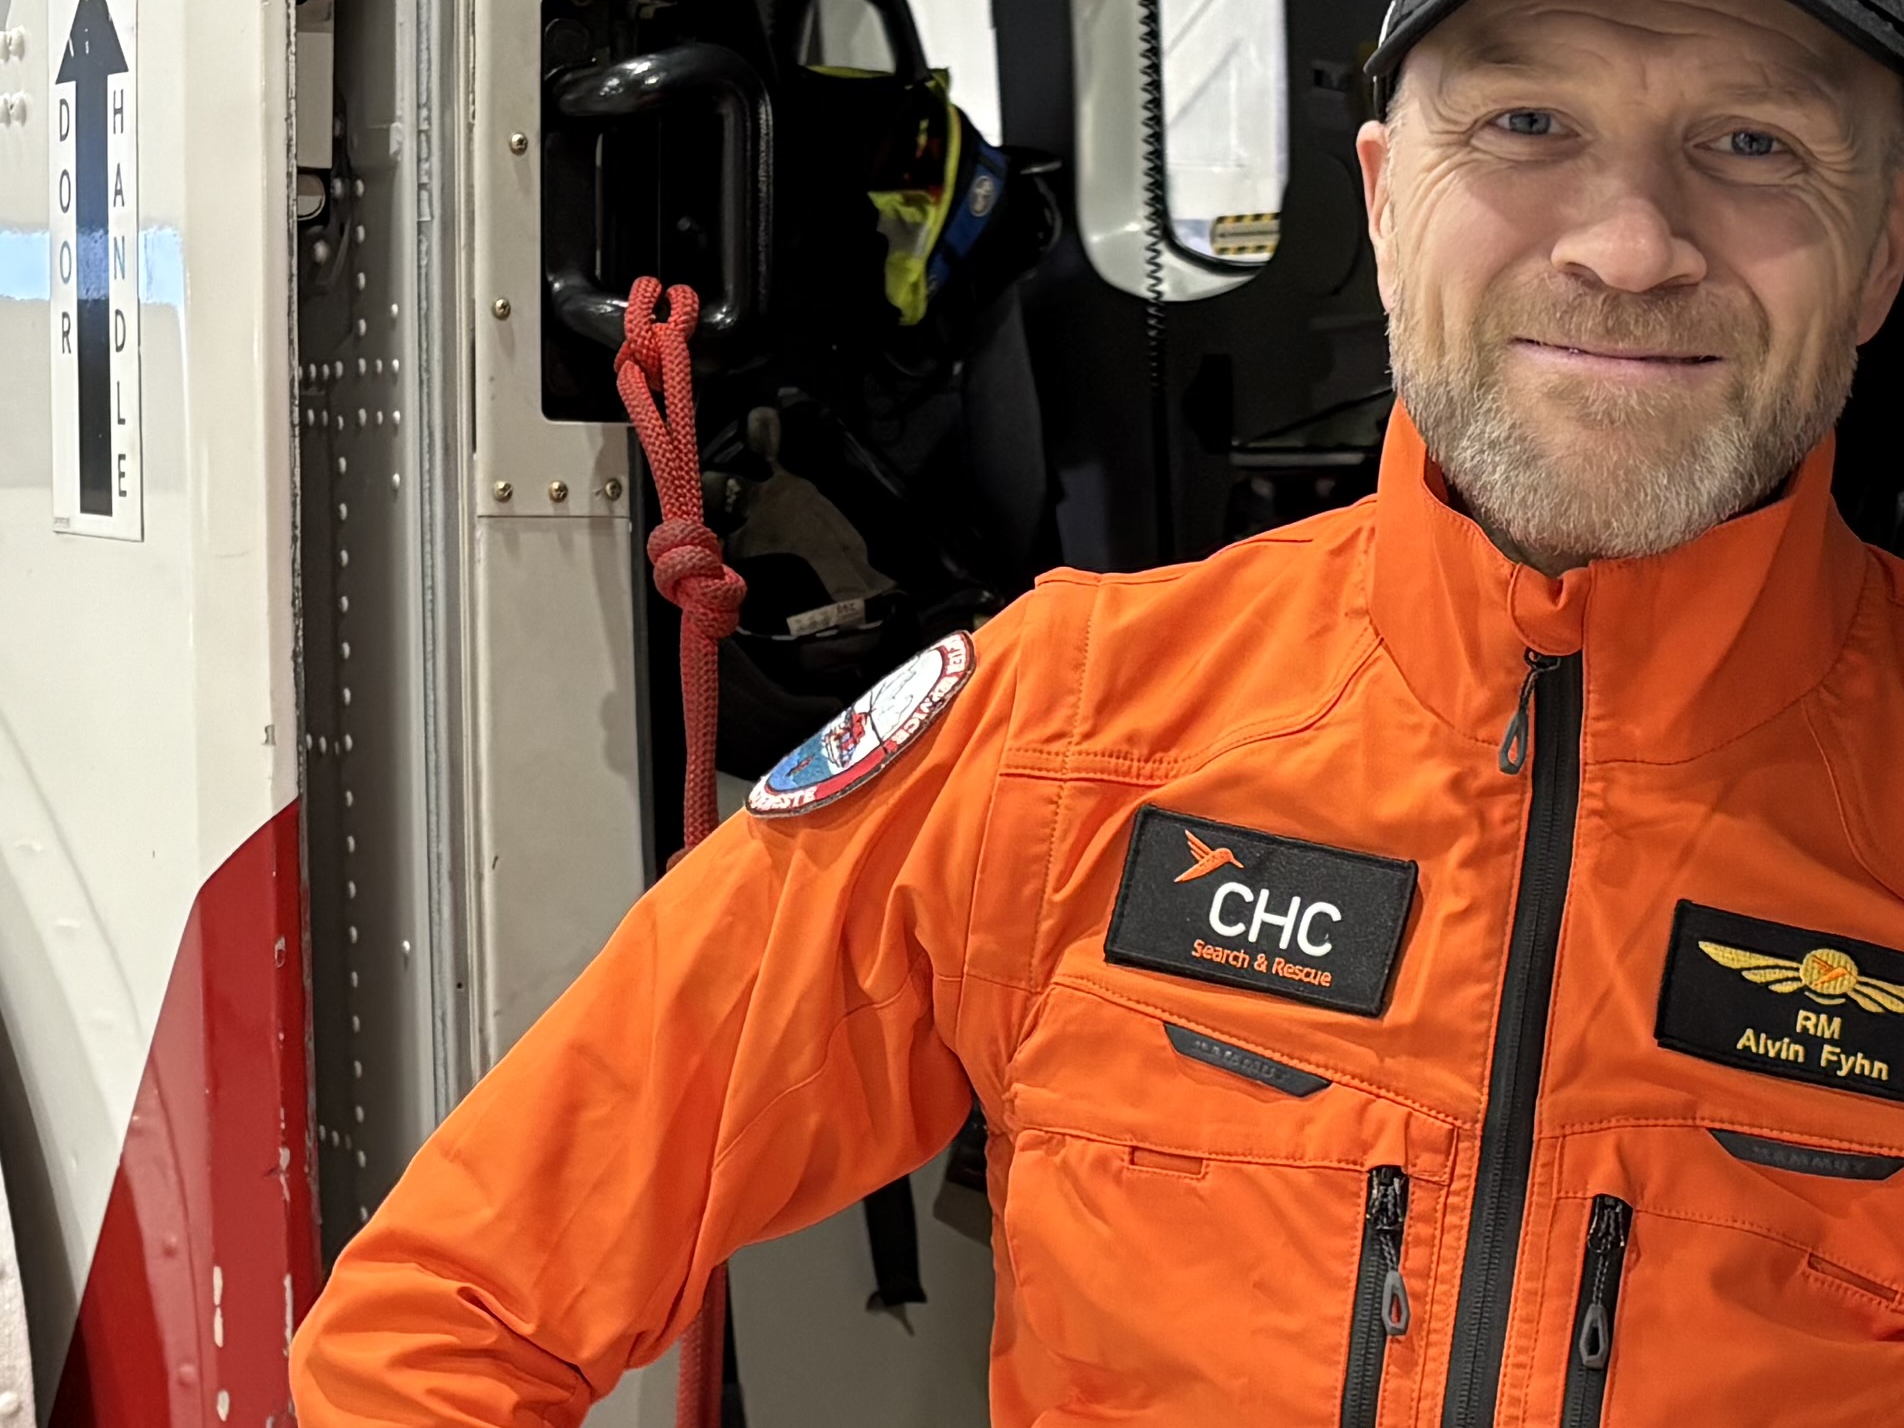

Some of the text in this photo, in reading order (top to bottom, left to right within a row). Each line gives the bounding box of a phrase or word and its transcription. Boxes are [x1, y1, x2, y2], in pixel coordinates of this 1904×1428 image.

[59, 98, 72, 354] DOOR
[112, 89, 127, 497] HANDLE
[1209, 881, 1342, 957] CHC
[1191, 938, 1333, 987] Search & Rescue
[1736, 1028, 1889, 1081] Alvin Fyhn
[1796, 1009, 1842, 1040] RM
